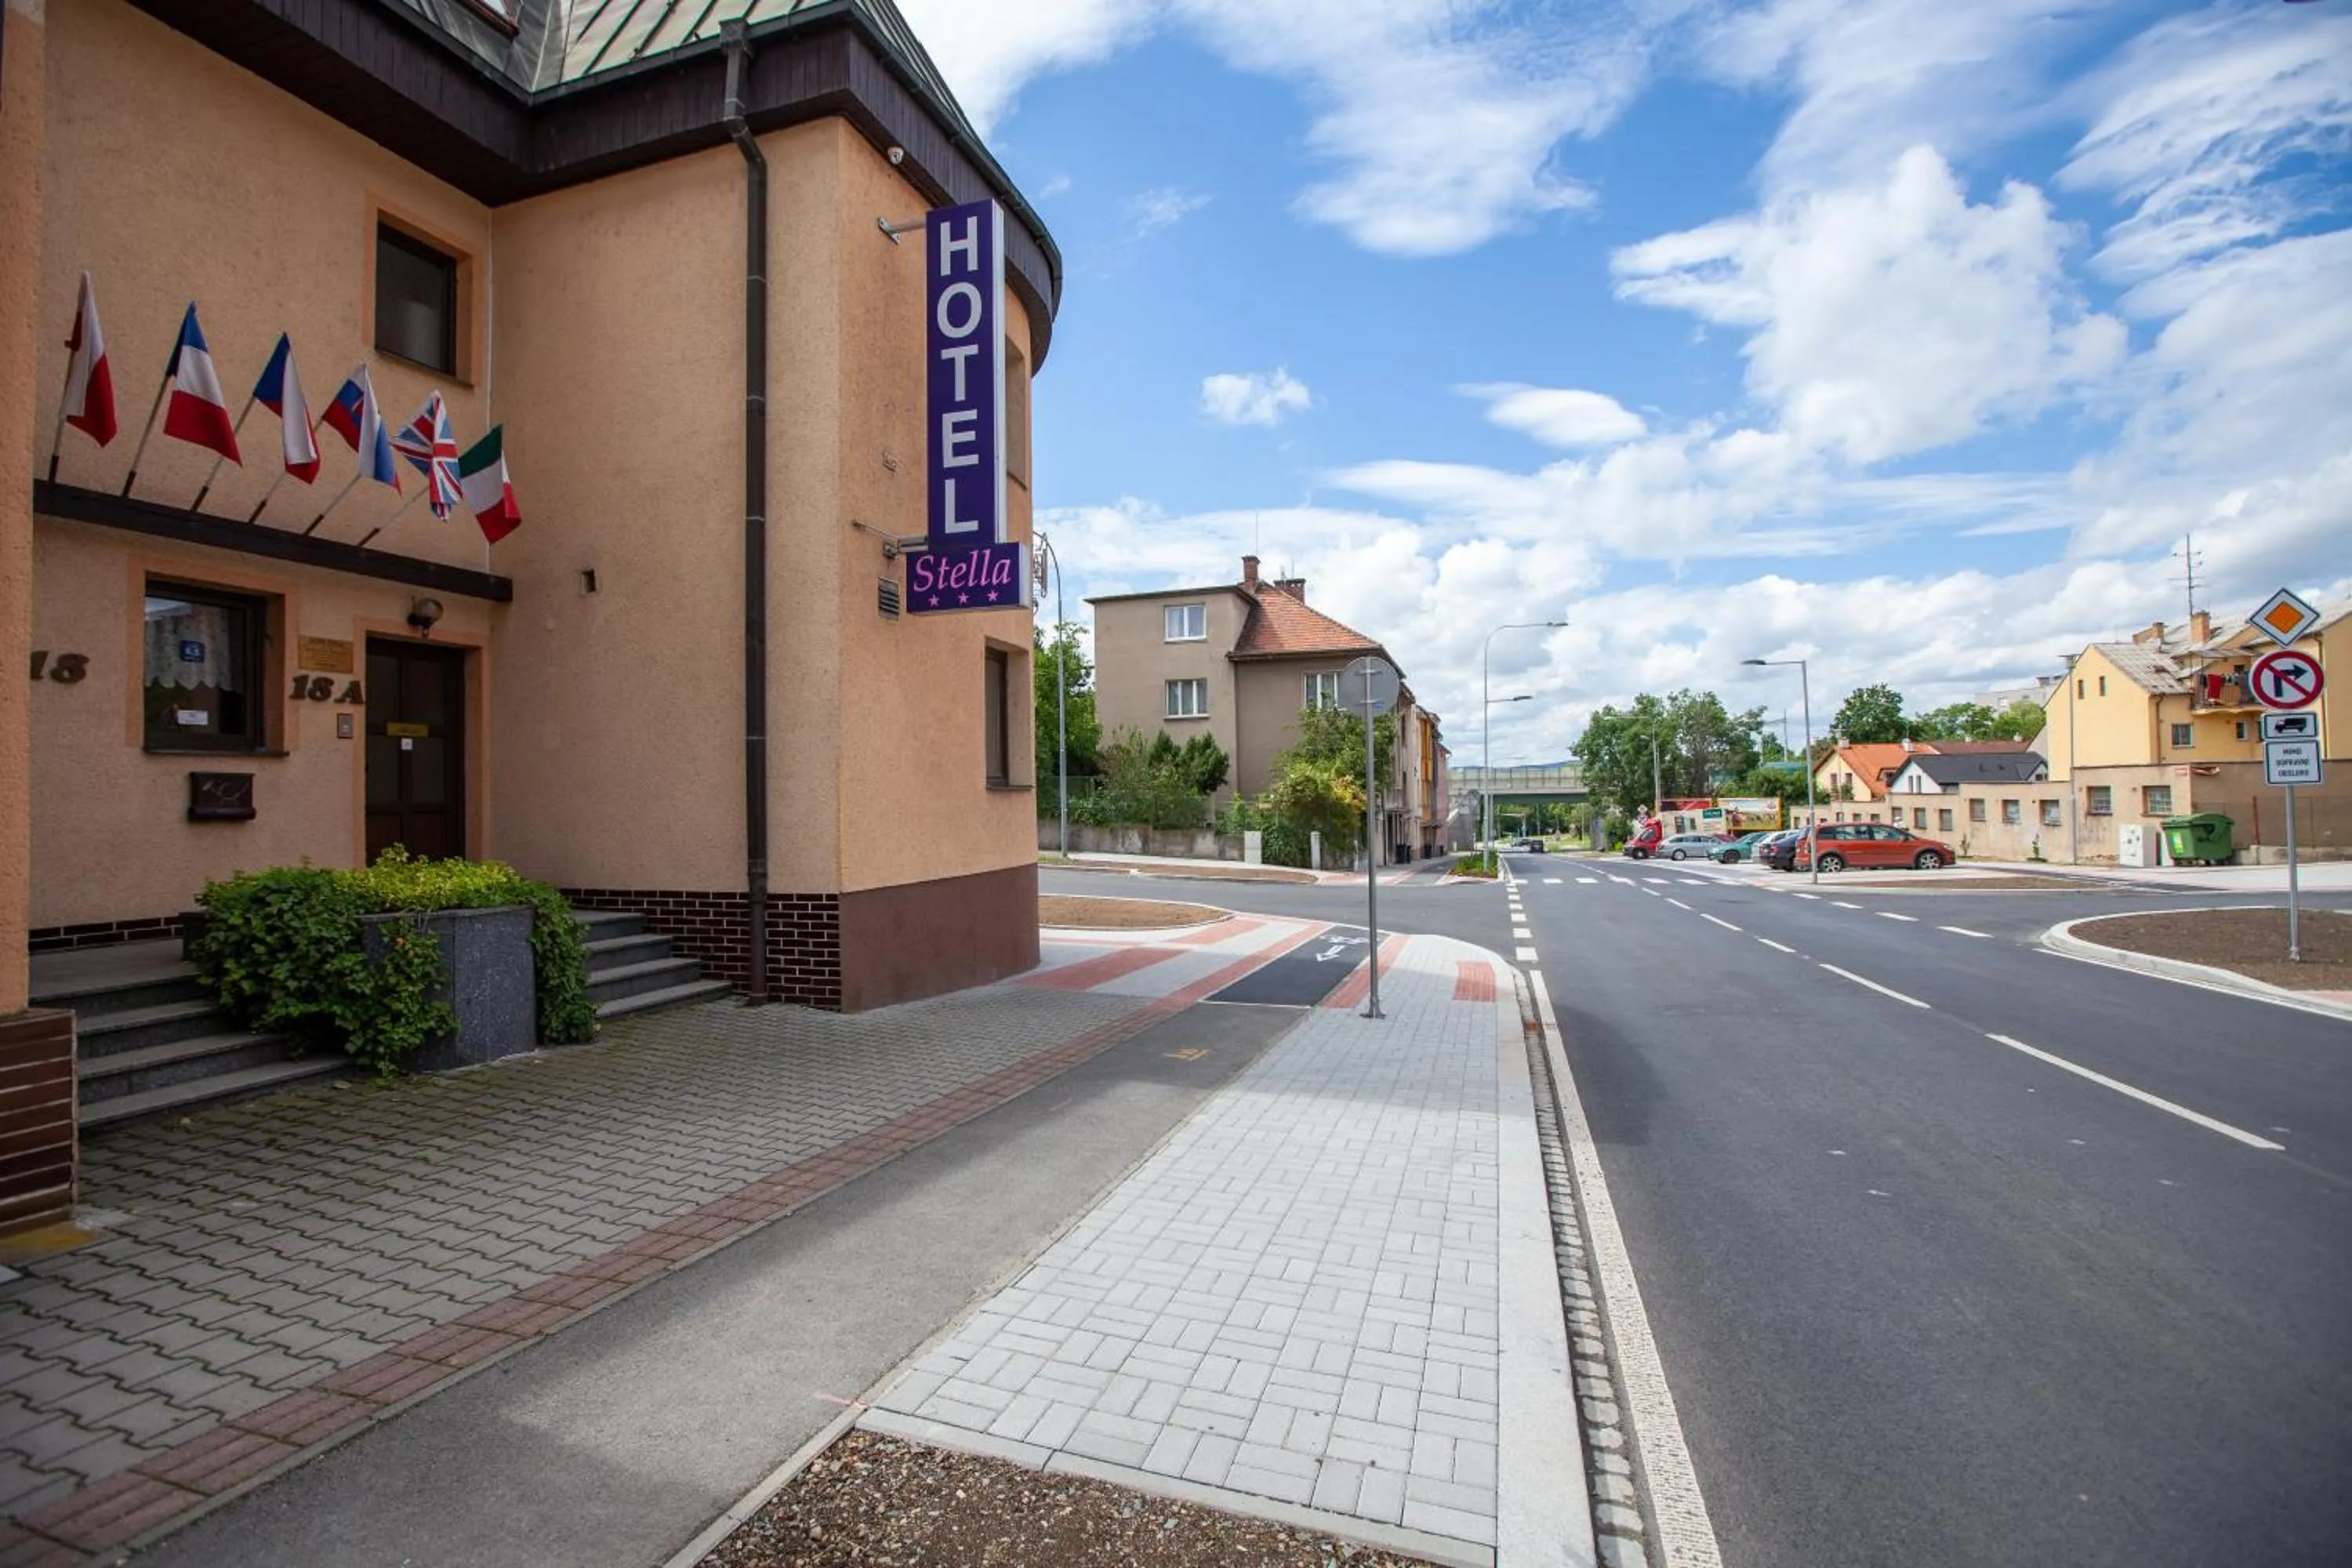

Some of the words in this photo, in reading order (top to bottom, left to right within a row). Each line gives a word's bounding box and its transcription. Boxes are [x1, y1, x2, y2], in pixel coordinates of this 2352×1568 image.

[936, 216, 982, 535] HOTEL
[913, 549, 1011, 592] Stella
[31, 650, 90, 684] 18
